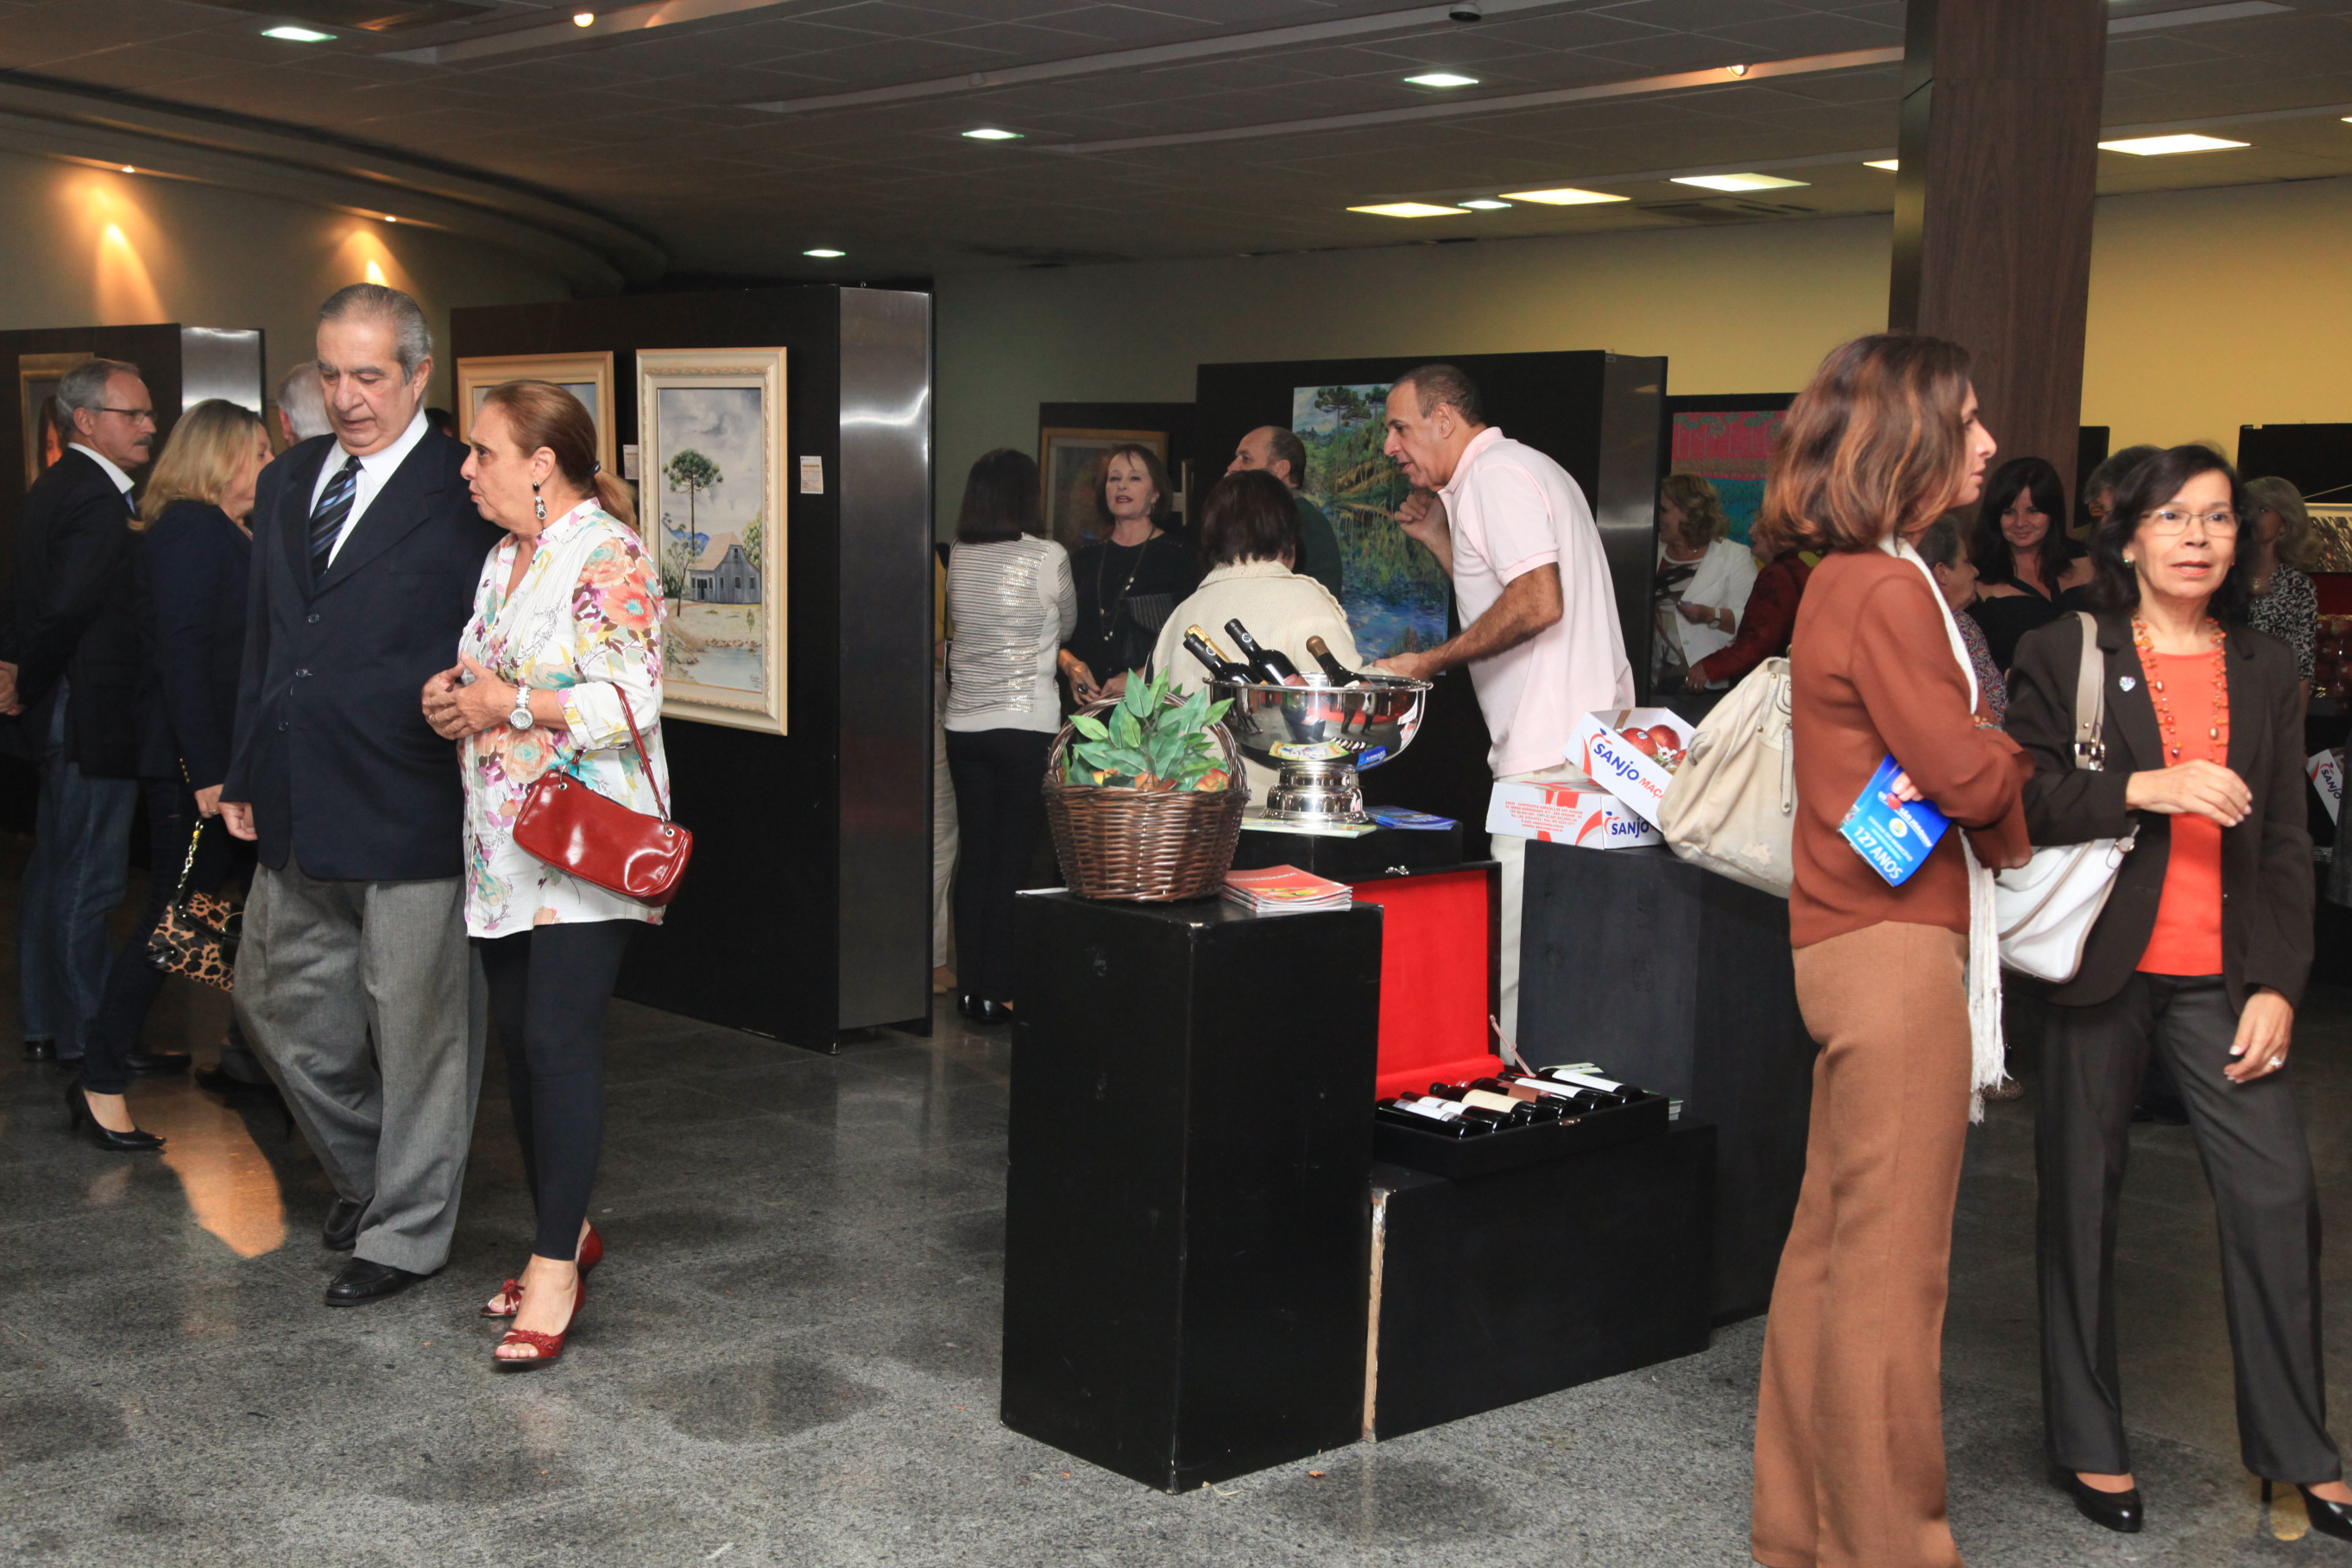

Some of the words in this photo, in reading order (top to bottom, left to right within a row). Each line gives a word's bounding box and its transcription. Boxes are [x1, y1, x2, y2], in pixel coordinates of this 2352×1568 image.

[1898, 808, 1913, 821] SÃO
[1909, 818, 1933, 847] JOAQUIM
[1853, 826, 1876, 847] 127
[1870, 847, 1903, 879] ANOS
